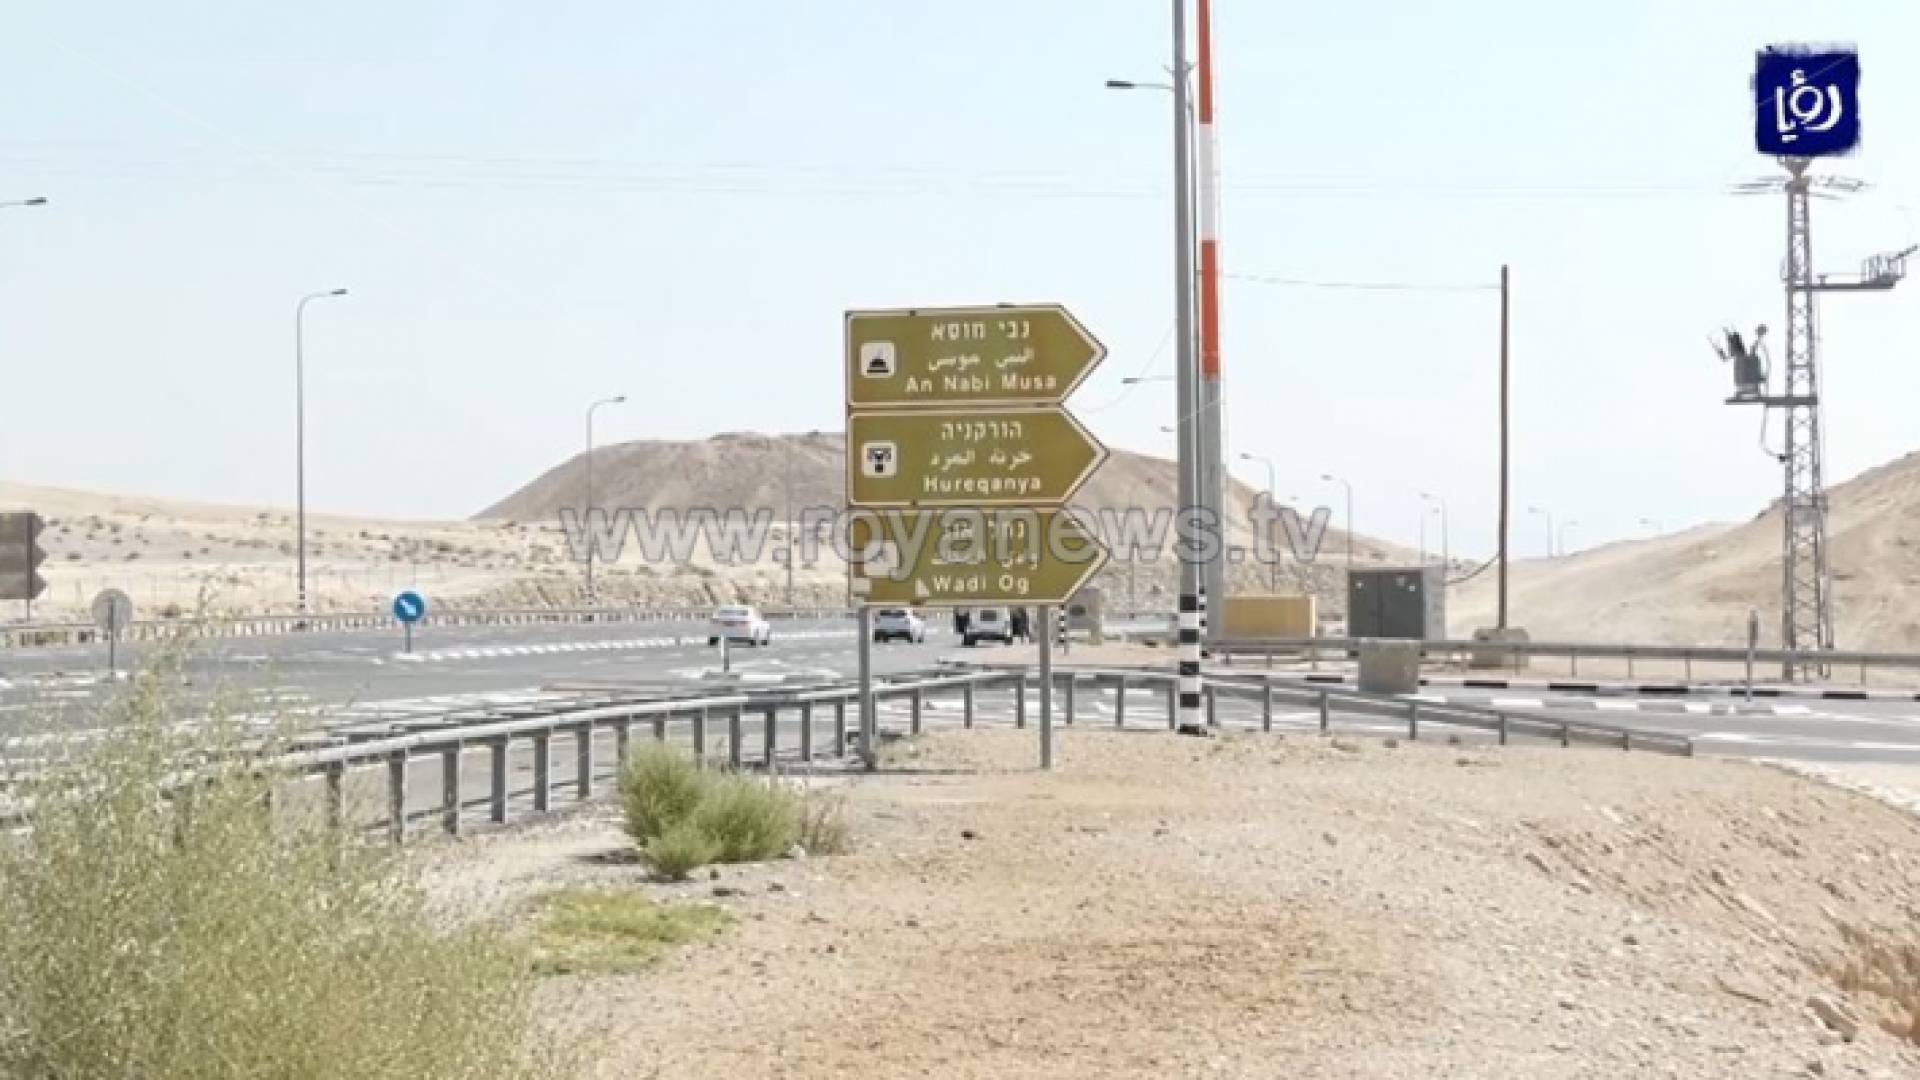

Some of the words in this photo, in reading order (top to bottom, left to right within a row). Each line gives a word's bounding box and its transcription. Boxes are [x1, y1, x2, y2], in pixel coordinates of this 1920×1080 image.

[930, 320, 987, 341] מוסא
[998, 320, 1031, 340] נבי
[904, 375, 934, 393] An
[943, 374, 990, 393] Nabi
[1001, 373, 1057, 391] Musa
[941, 420, 1023, 442] הורקניה
[922, 475, 1042, 495] Hureqanya
[932, 574, 987, 593] Wadi
[999, 573, 1030, 594] Og
